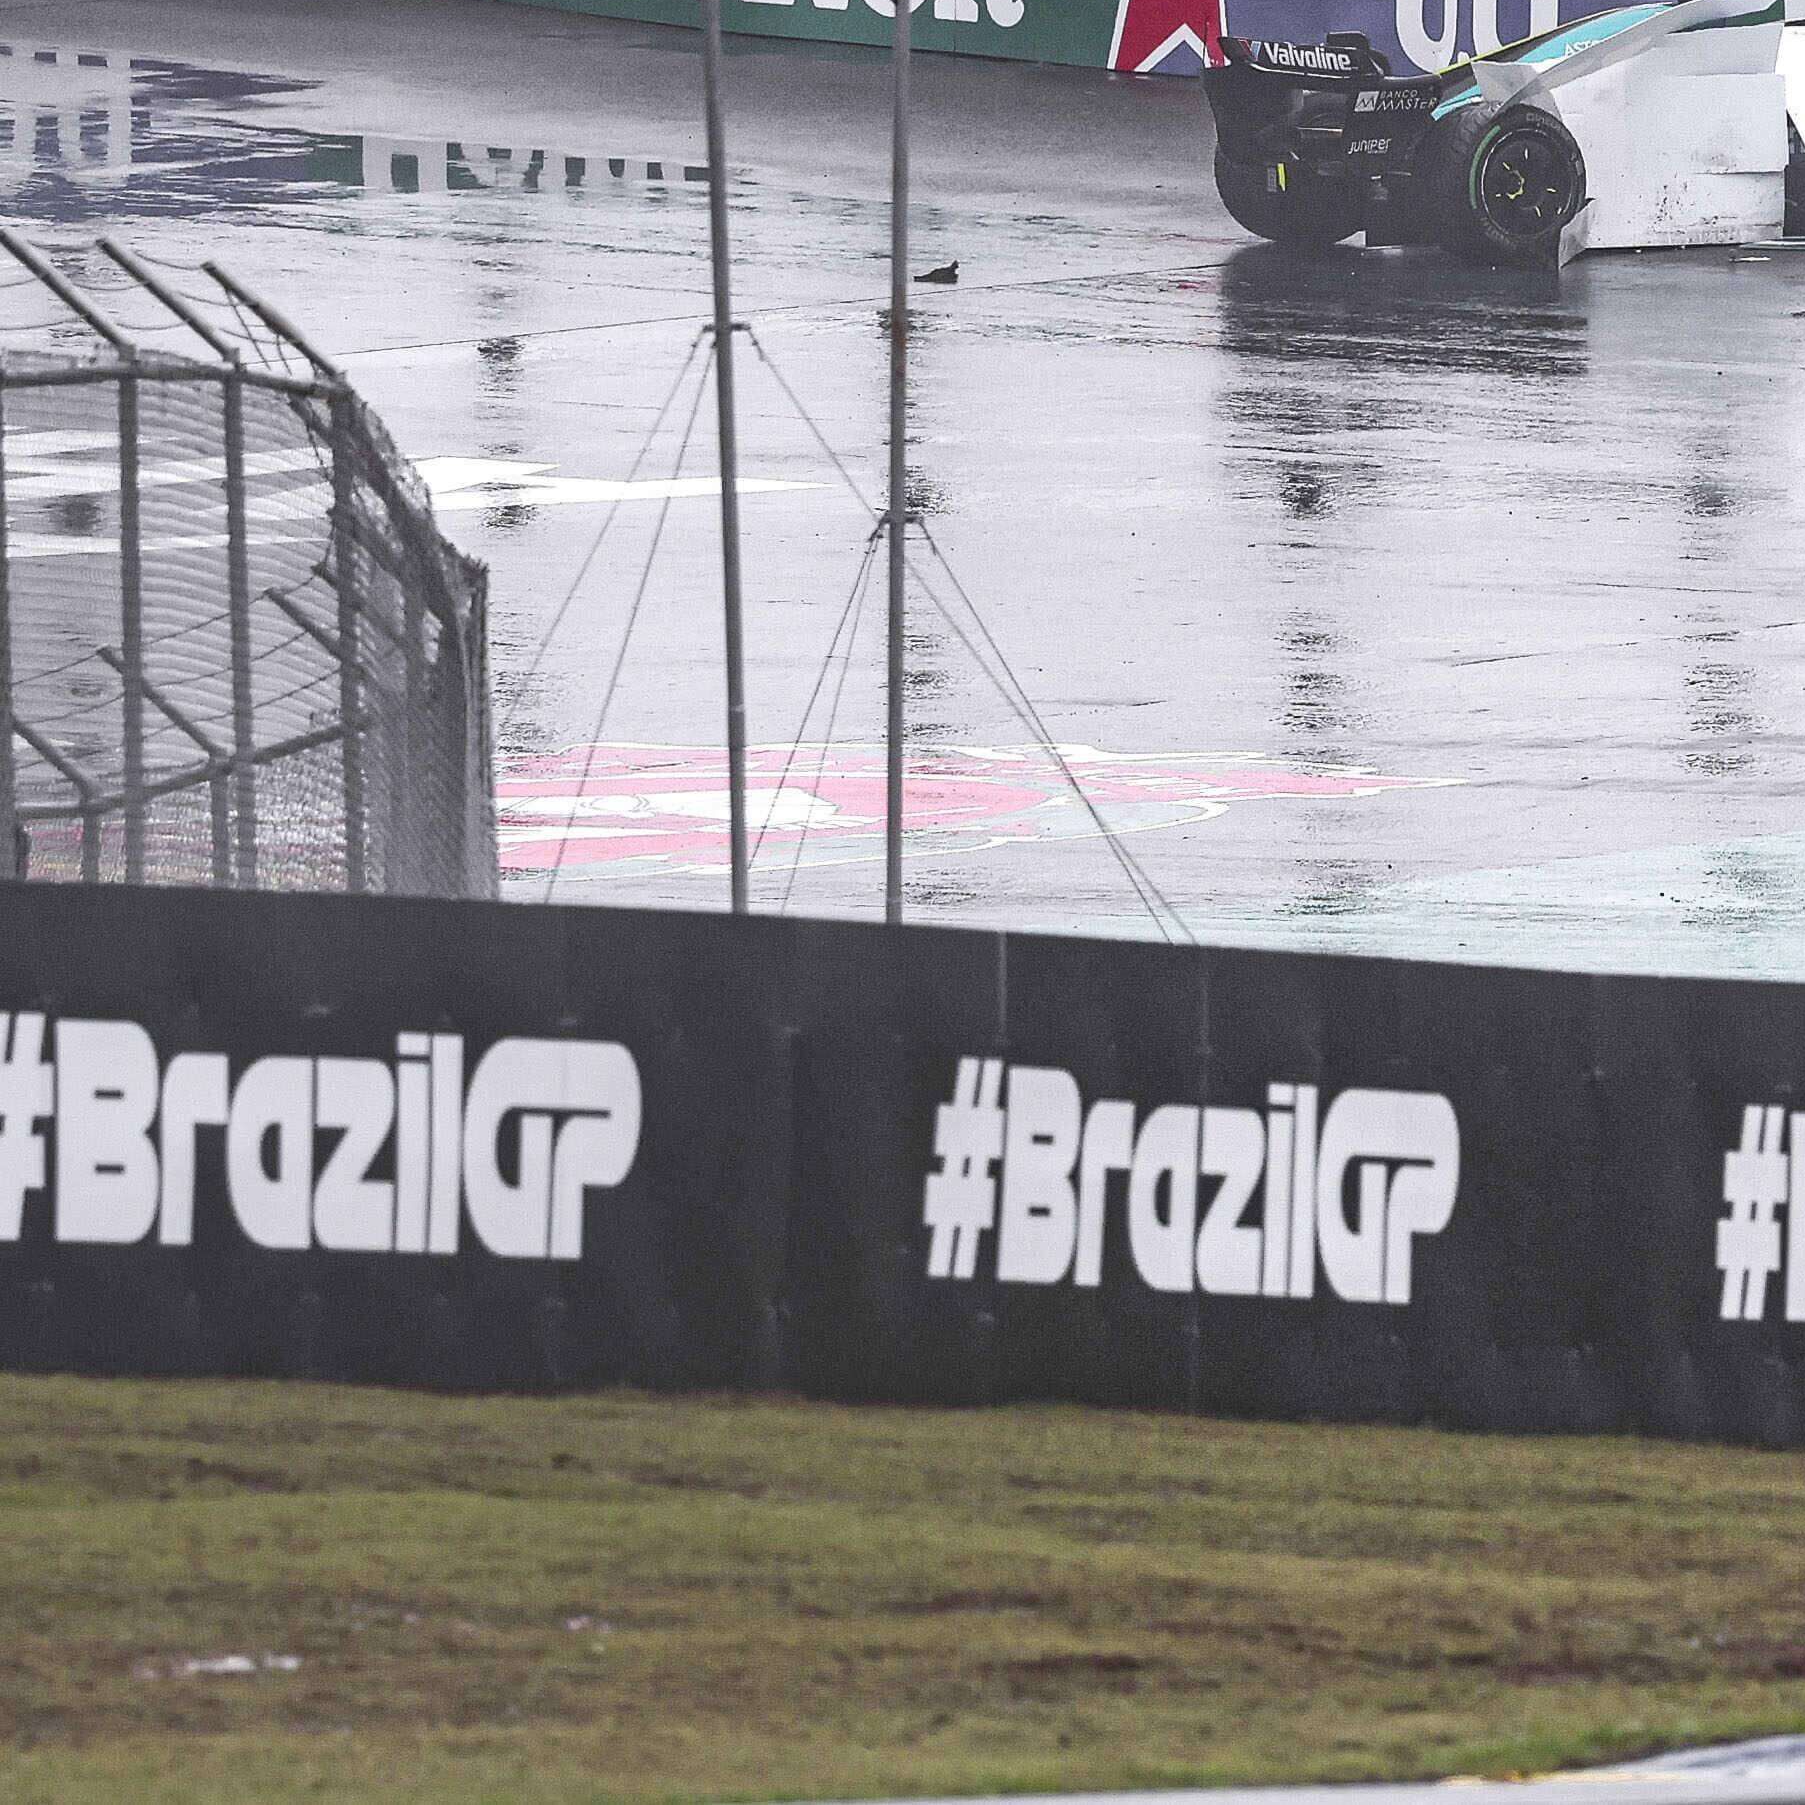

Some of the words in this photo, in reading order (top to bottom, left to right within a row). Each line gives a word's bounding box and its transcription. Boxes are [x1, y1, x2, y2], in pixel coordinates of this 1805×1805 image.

[1263, 40, 1352, 71] Valvoline
[1377, 97, 1437, 111] MASTER
[1380, 89, 1418, 99] BANCO
[0, 1012, 642, 1260] #BrazilGP
[923, 1057, 1460, 1305] #BrazilGP
